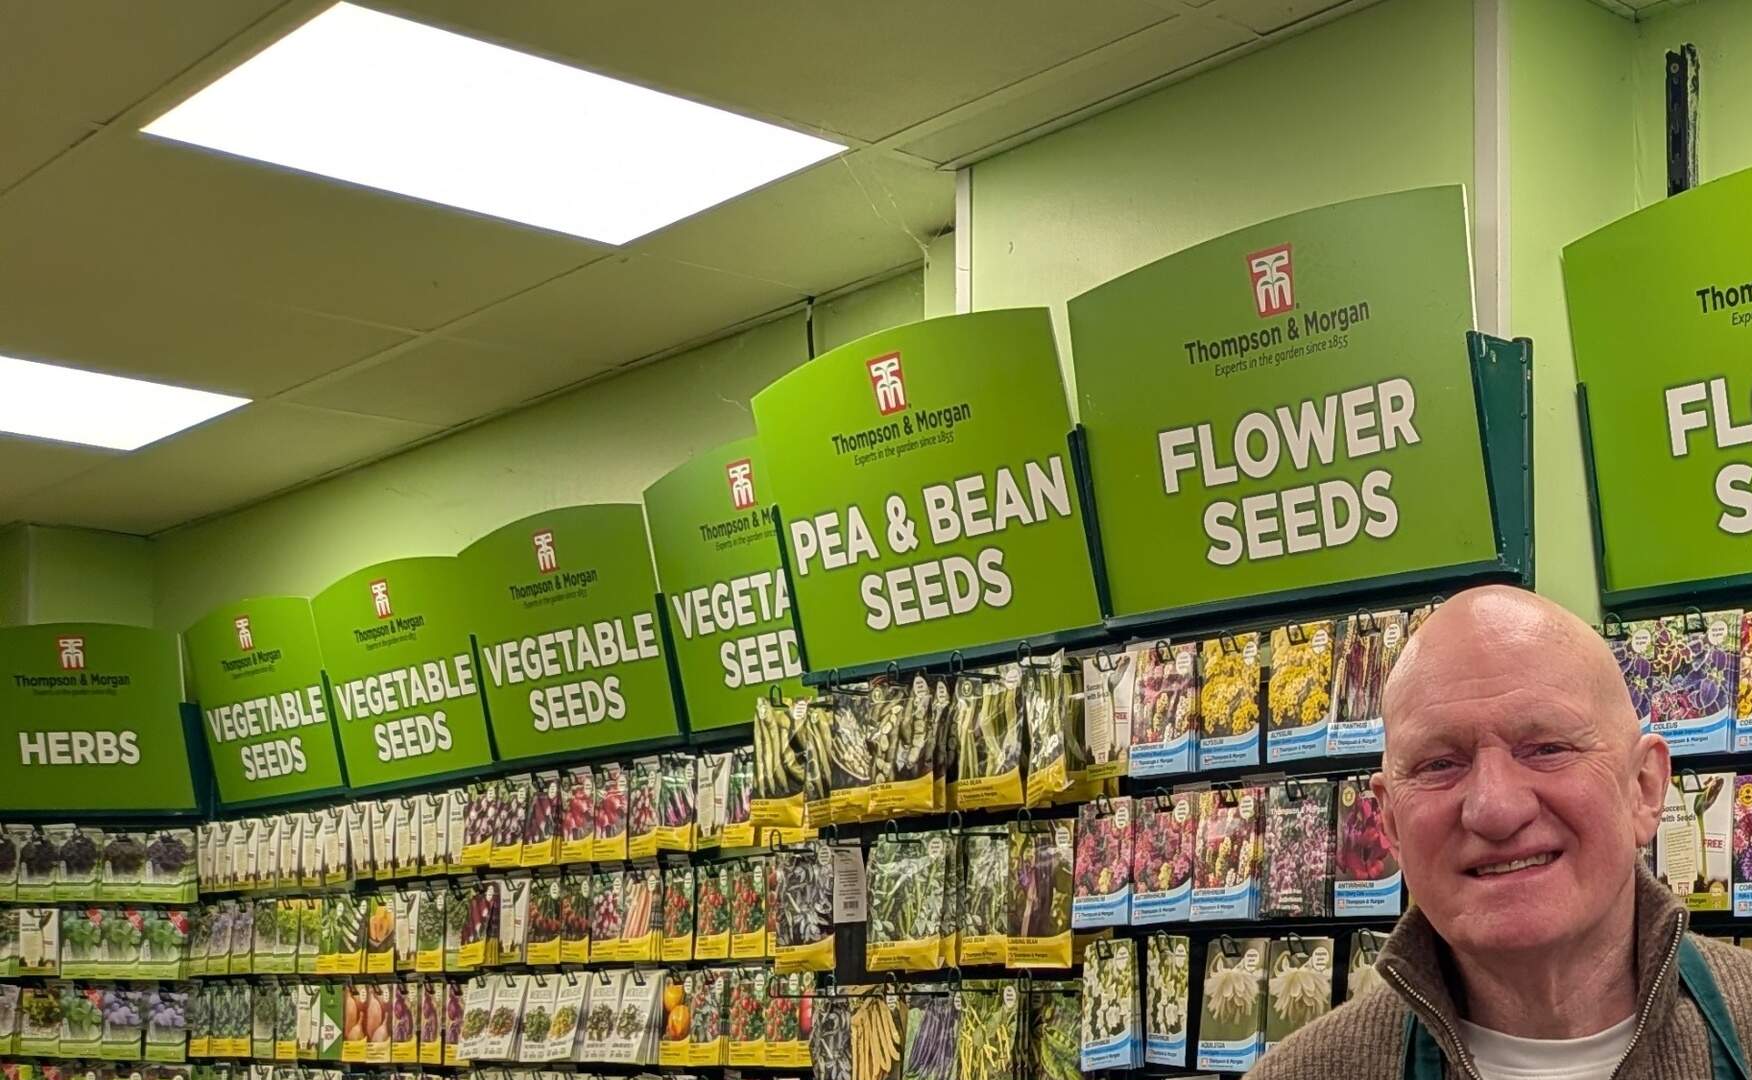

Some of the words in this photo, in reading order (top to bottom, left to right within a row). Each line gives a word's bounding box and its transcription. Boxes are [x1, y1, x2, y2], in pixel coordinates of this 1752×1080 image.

[1185, 324, 1282, 365] Thompson
[1287, 316, 1299, 340] &
[1304, 300, 1370, 337] Morgan
[1215, 356, 1247, 376] Experts
[1248, 355, 1256, 367] in
[1258, 352, 1273, 367] the
[1274, 345, 1304, 367] garden
[1306, 339, 1327, 357] since
[1328, 334, 1349, 351] 1855
[832, 423, 900, 456] Thompson
[902, 420, 914, 436] &
[916, 402, 971, 435] Morgan
[855, 449, 877, 466] Experts
[878, 447, 885, 458] in
[886, 443, 895, 457] the
[896, 438, 918, 457] garden
[919, 434, 937, 447] since
[938, 430, 954, 446] 1855
[1158, 378, 1420, 493] FLOWER
[700, 517, 750, 544] Thompson
[751, 513, 760, 527] &
[790, 506, 879, 576] PEA
[886, 495, 918, 553] &
[923, 456, 1070, 544] BEAN
[1204, 470, 1397, 565] SEEDS
[509, 581, 553, 601] Thompson
[555, 578, 562, 590] &
[562, 568, 597, 589] Morgan
[672, 568, 790, 639] VEGETA
[861, 548, 1012, 630] SEEDS
[354, 624, 388, 644] Thompson
[389, 621, 396, 632] &
[397, 614, 424, 633] Morgan
[483, 613, 659, 687] VEGETABLE
[14, 674, 76, 689] Thompson
[80, 674, 88, 686] &
[92, 673, 129, 687] Morgan
[720, 630, 802, 689] SEED
[207, 686, 326, 742] VEGETABLE
[335, 655, 477, 721] VEGETABLE
[530, 676, 626, 732] SEEDS
[20, 732, 140, 765] HERBS
[240, 737, 306, 780] SEEDS
[374, 712, 452, 762] SEEDS
